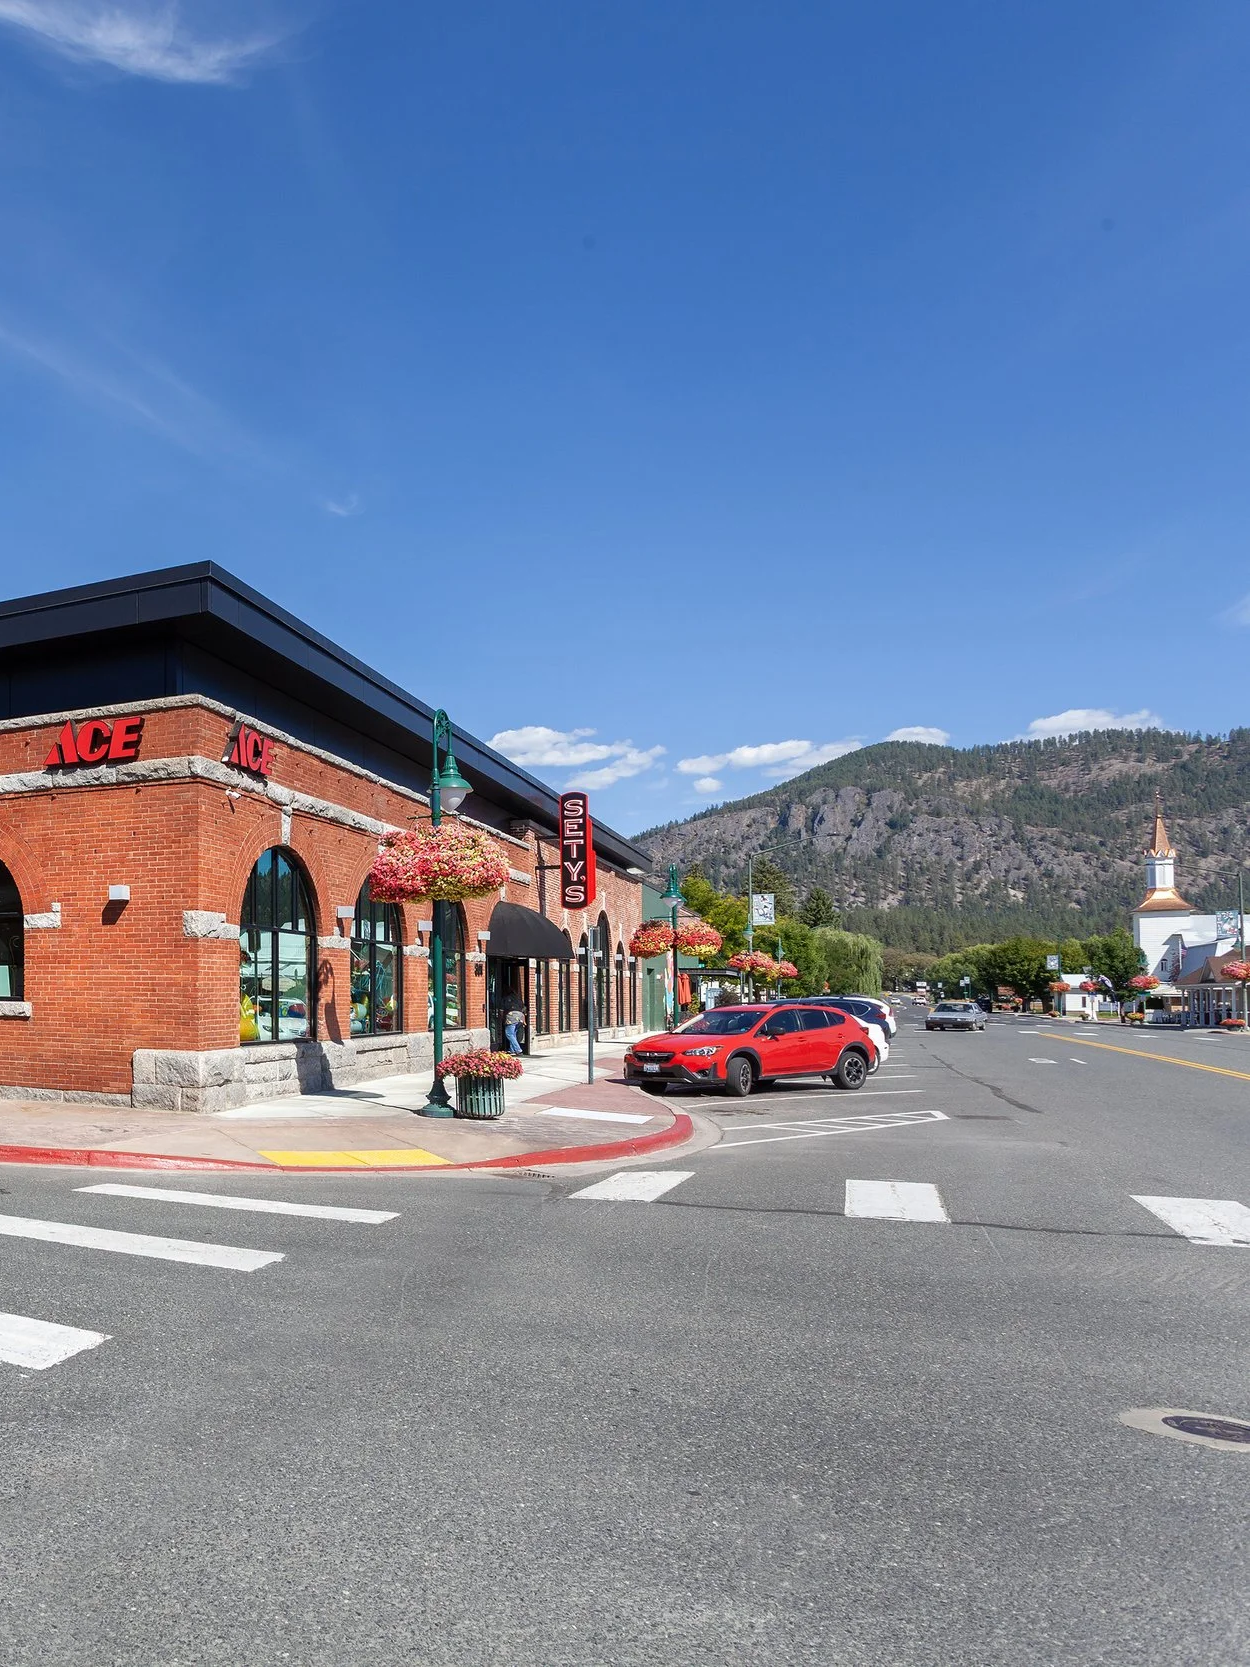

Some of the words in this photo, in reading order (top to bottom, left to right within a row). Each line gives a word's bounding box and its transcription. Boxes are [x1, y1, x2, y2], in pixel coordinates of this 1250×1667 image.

[43, 716, 142, 767] ACE
[230, 722, 275, 776] ACE
[563, 799, 586, 903] SETY'S
